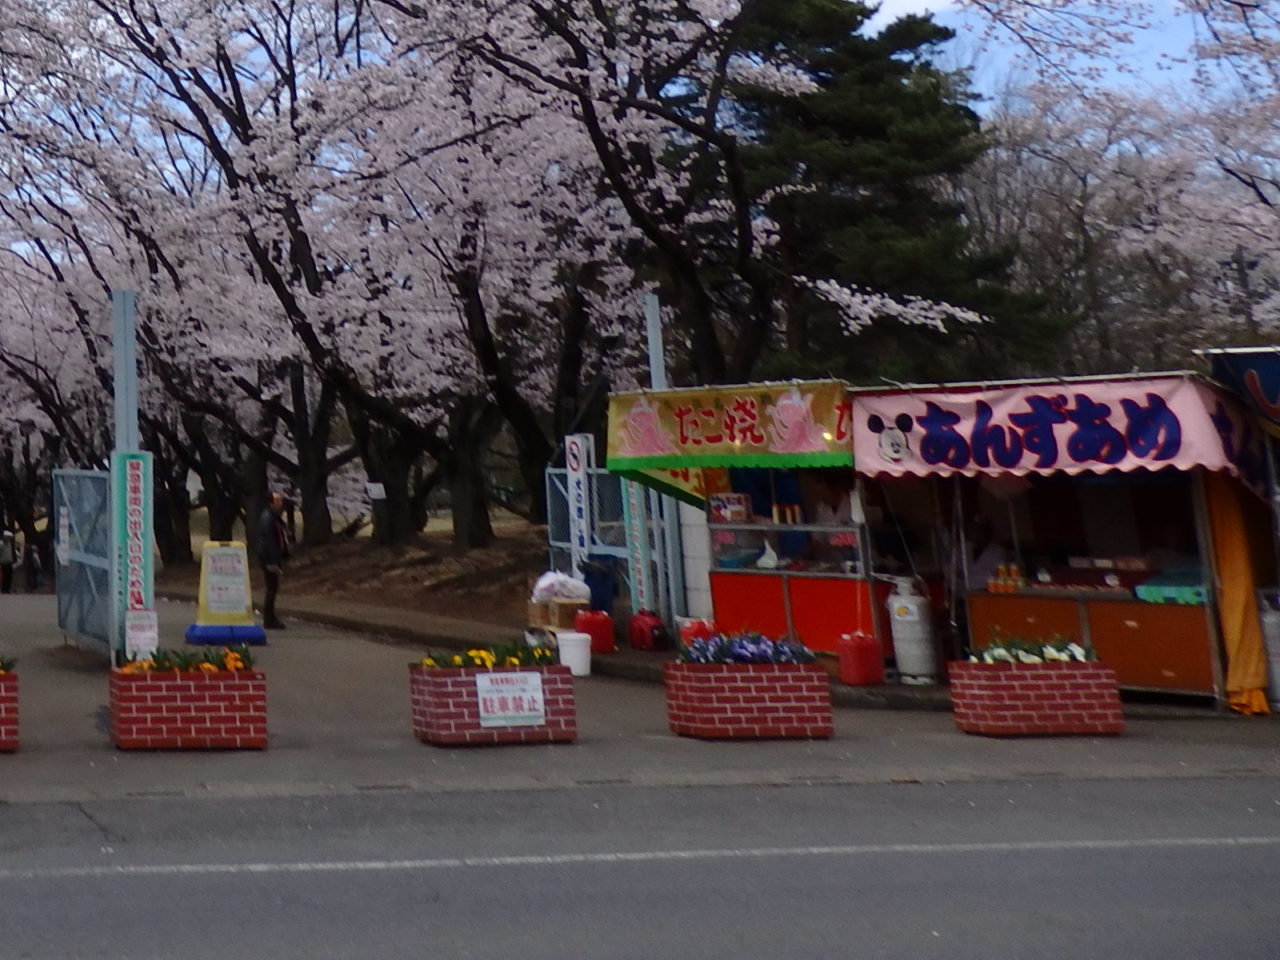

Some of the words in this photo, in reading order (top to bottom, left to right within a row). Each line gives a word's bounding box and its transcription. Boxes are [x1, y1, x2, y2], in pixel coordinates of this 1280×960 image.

[674, 397, 765, 445] たこ焼
[916, 391, 1182, 469] あんずあめ
